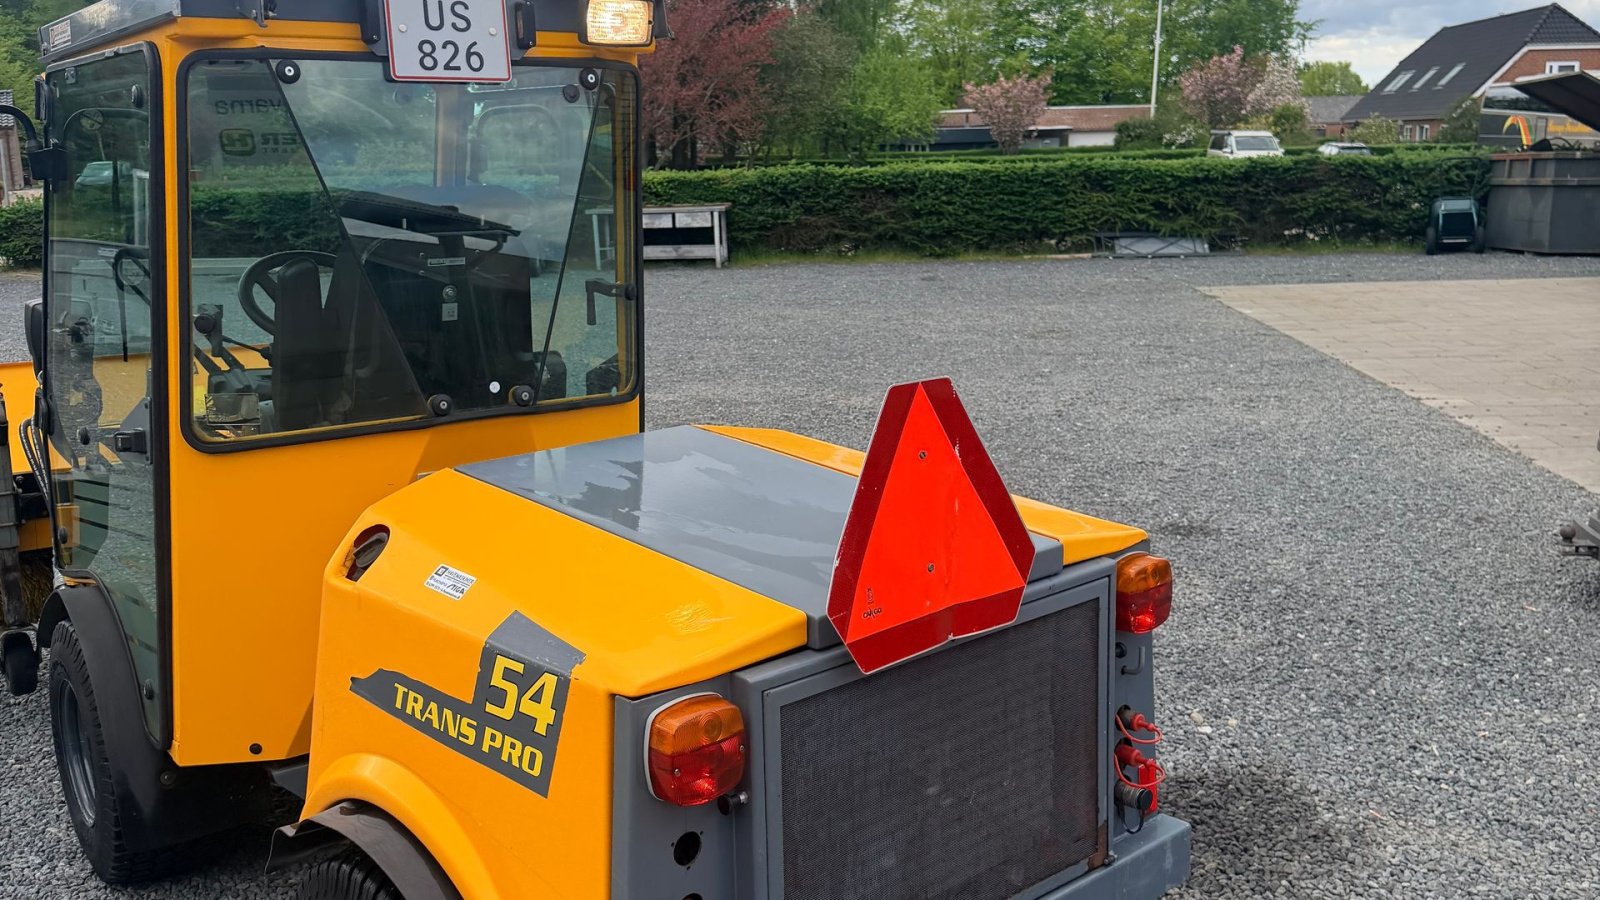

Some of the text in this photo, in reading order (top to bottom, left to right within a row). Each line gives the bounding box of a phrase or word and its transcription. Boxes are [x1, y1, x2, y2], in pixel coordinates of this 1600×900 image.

[423, 0, 471, 32] US
[418, 39, 484, 72] 826
[485, 654, 558, 737] 54
[394, 682, 543, 777] TRANS PRO
